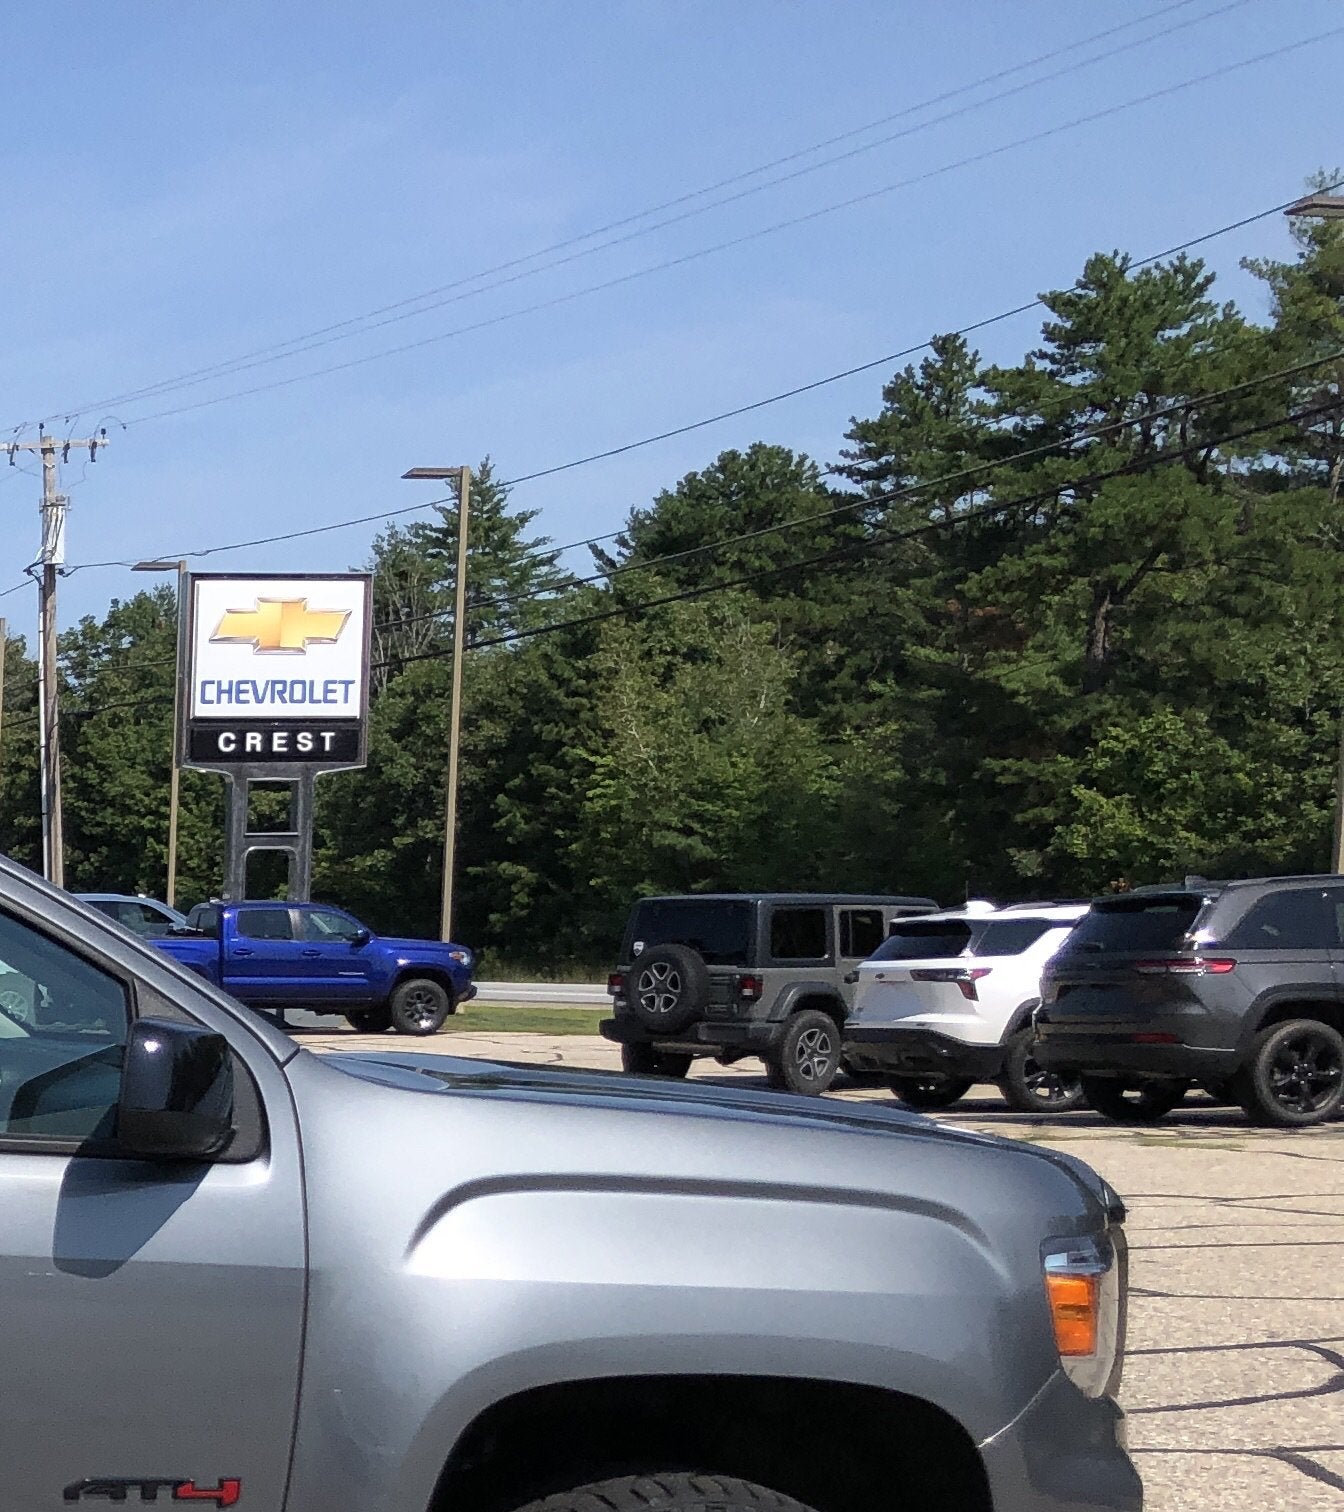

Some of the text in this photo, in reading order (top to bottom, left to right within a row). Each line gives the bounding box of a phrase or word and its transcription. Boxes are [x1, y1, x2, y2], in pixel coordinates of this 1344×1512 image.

[200, 679, 356, 705] CHEVROLET
[217, 732, 336, 752] CREST
[63, 1477, 242, 1508] AT4
